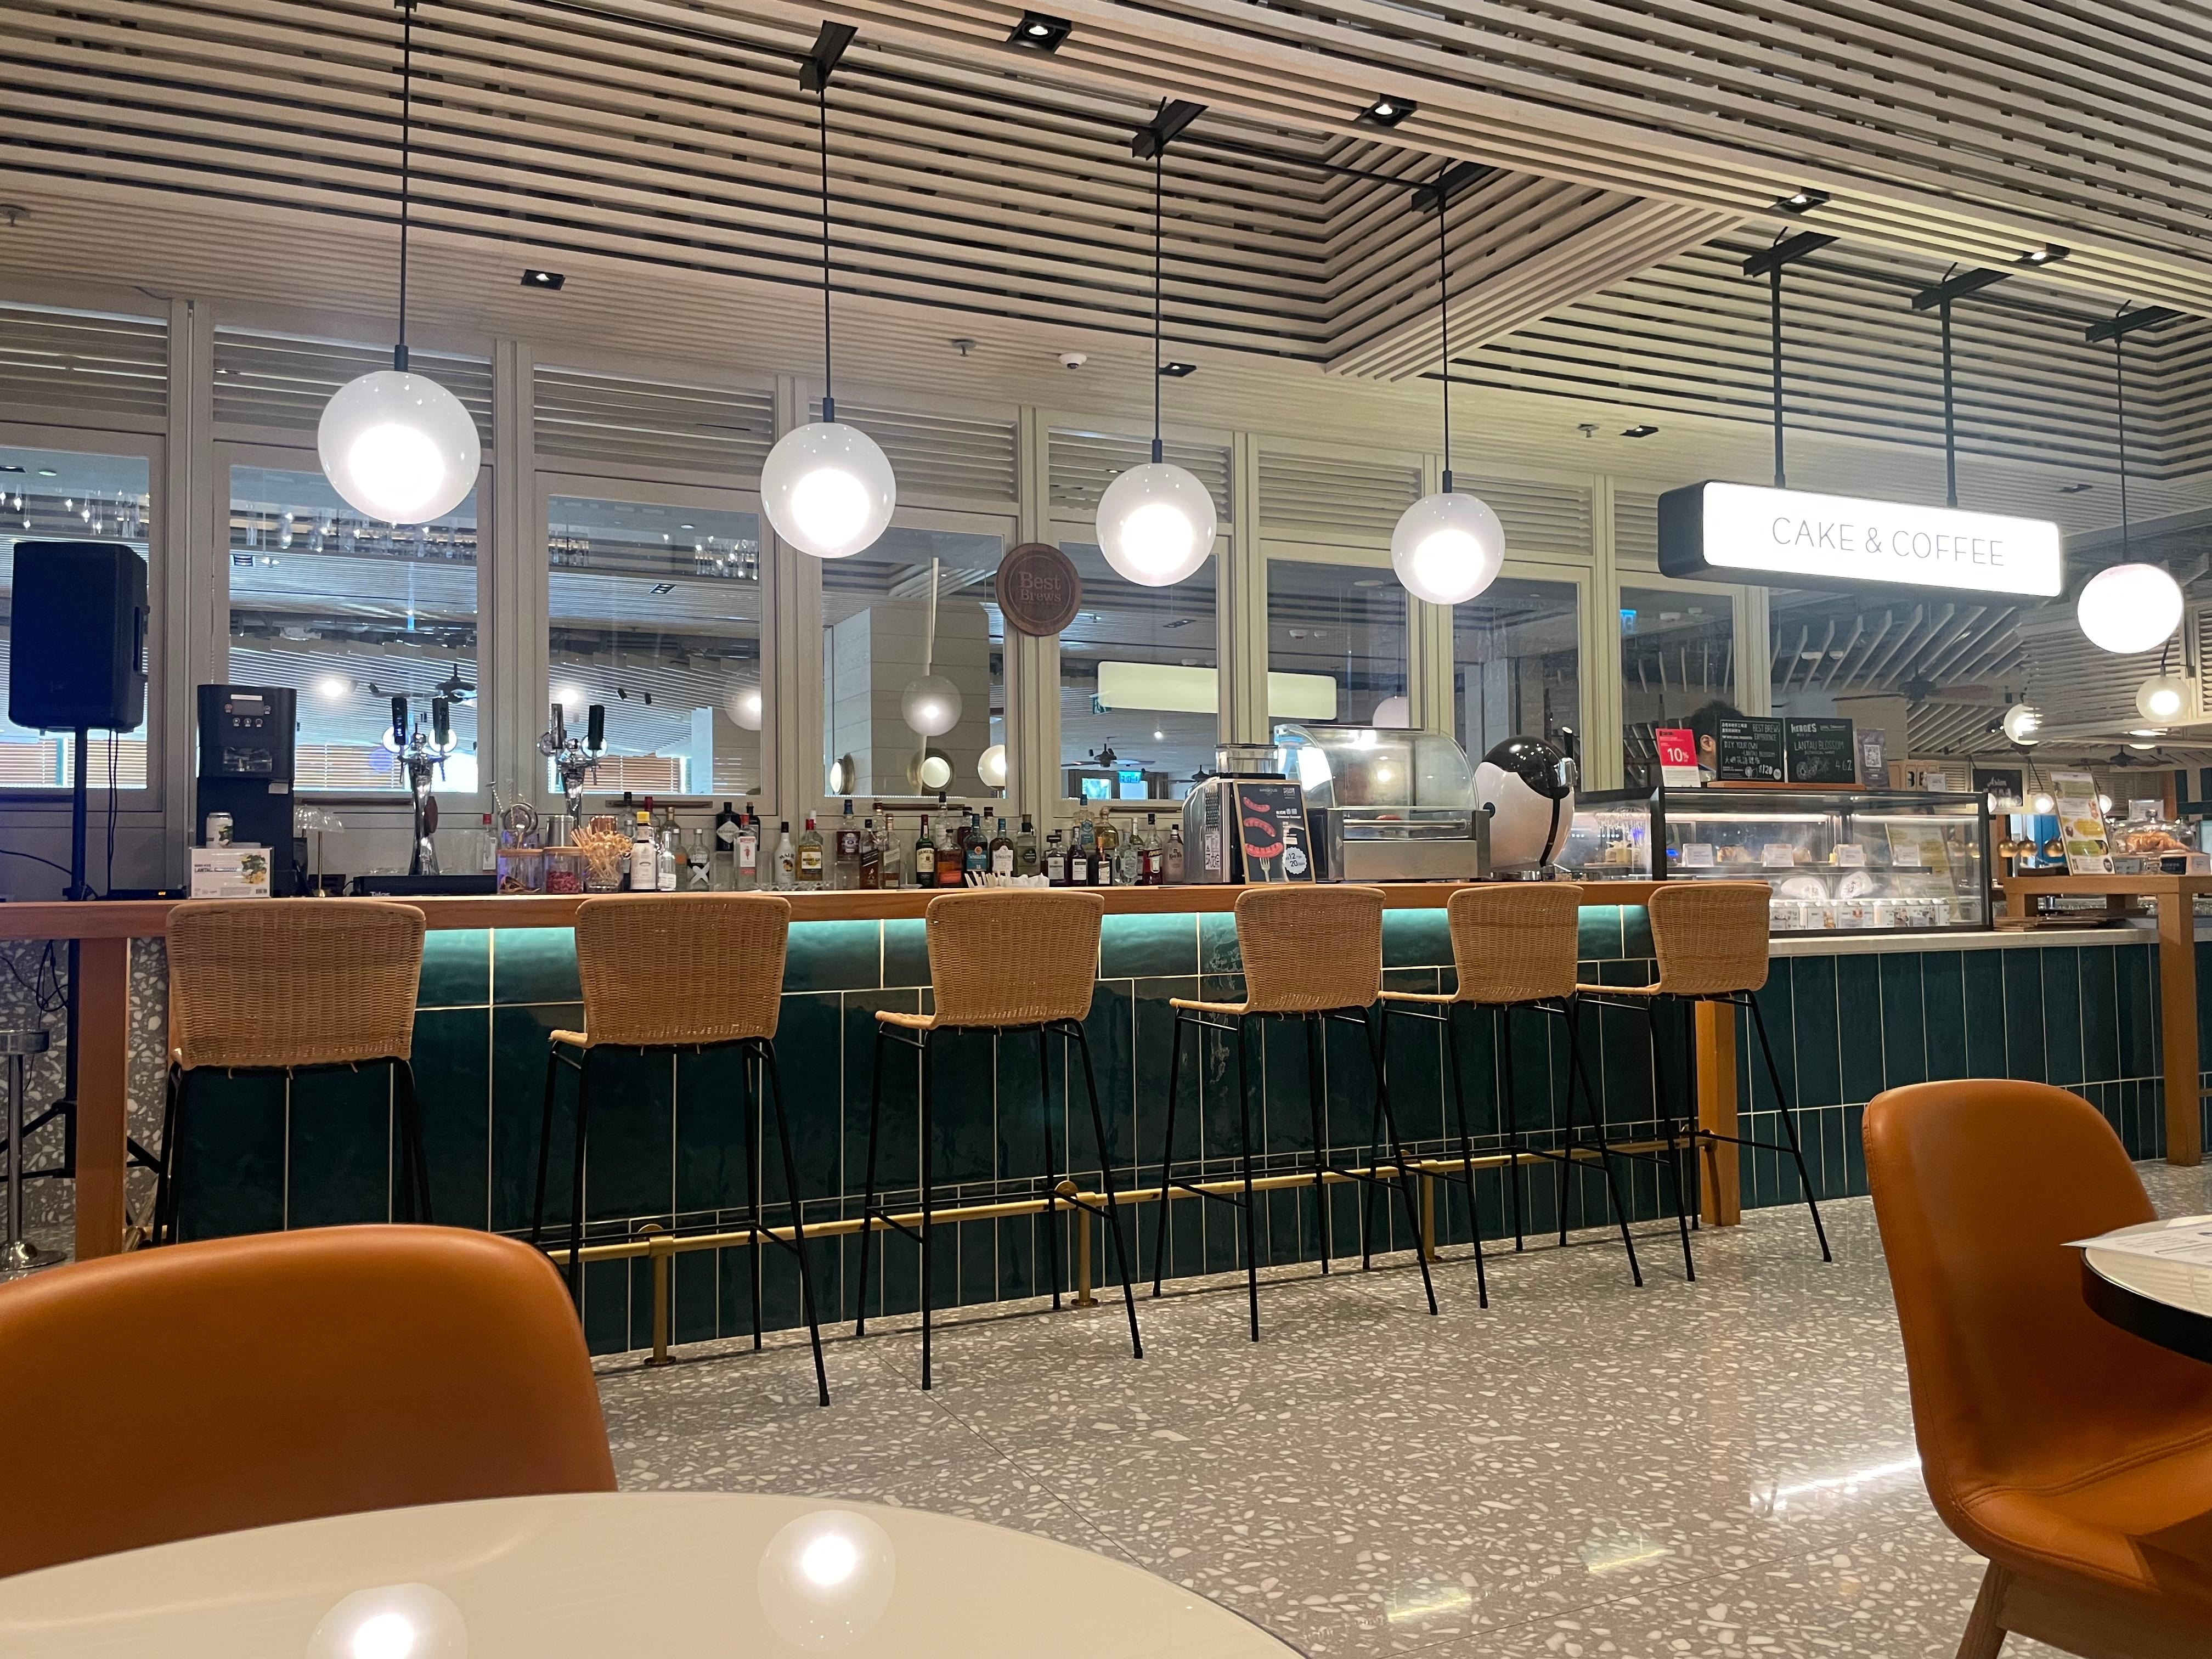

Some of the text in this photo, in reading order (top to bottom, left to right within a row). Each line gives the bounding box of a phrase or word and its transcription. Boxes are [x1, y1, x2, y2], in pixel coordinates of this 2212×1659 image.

[1771, 517, 2005, 566] CAKE & COFFEE
[1018, 571, 1062, 591] Best
[1019, 588, 1062, 602] Brews
[1794, 740, 1844, 751] LANTAU BLOSSOM
